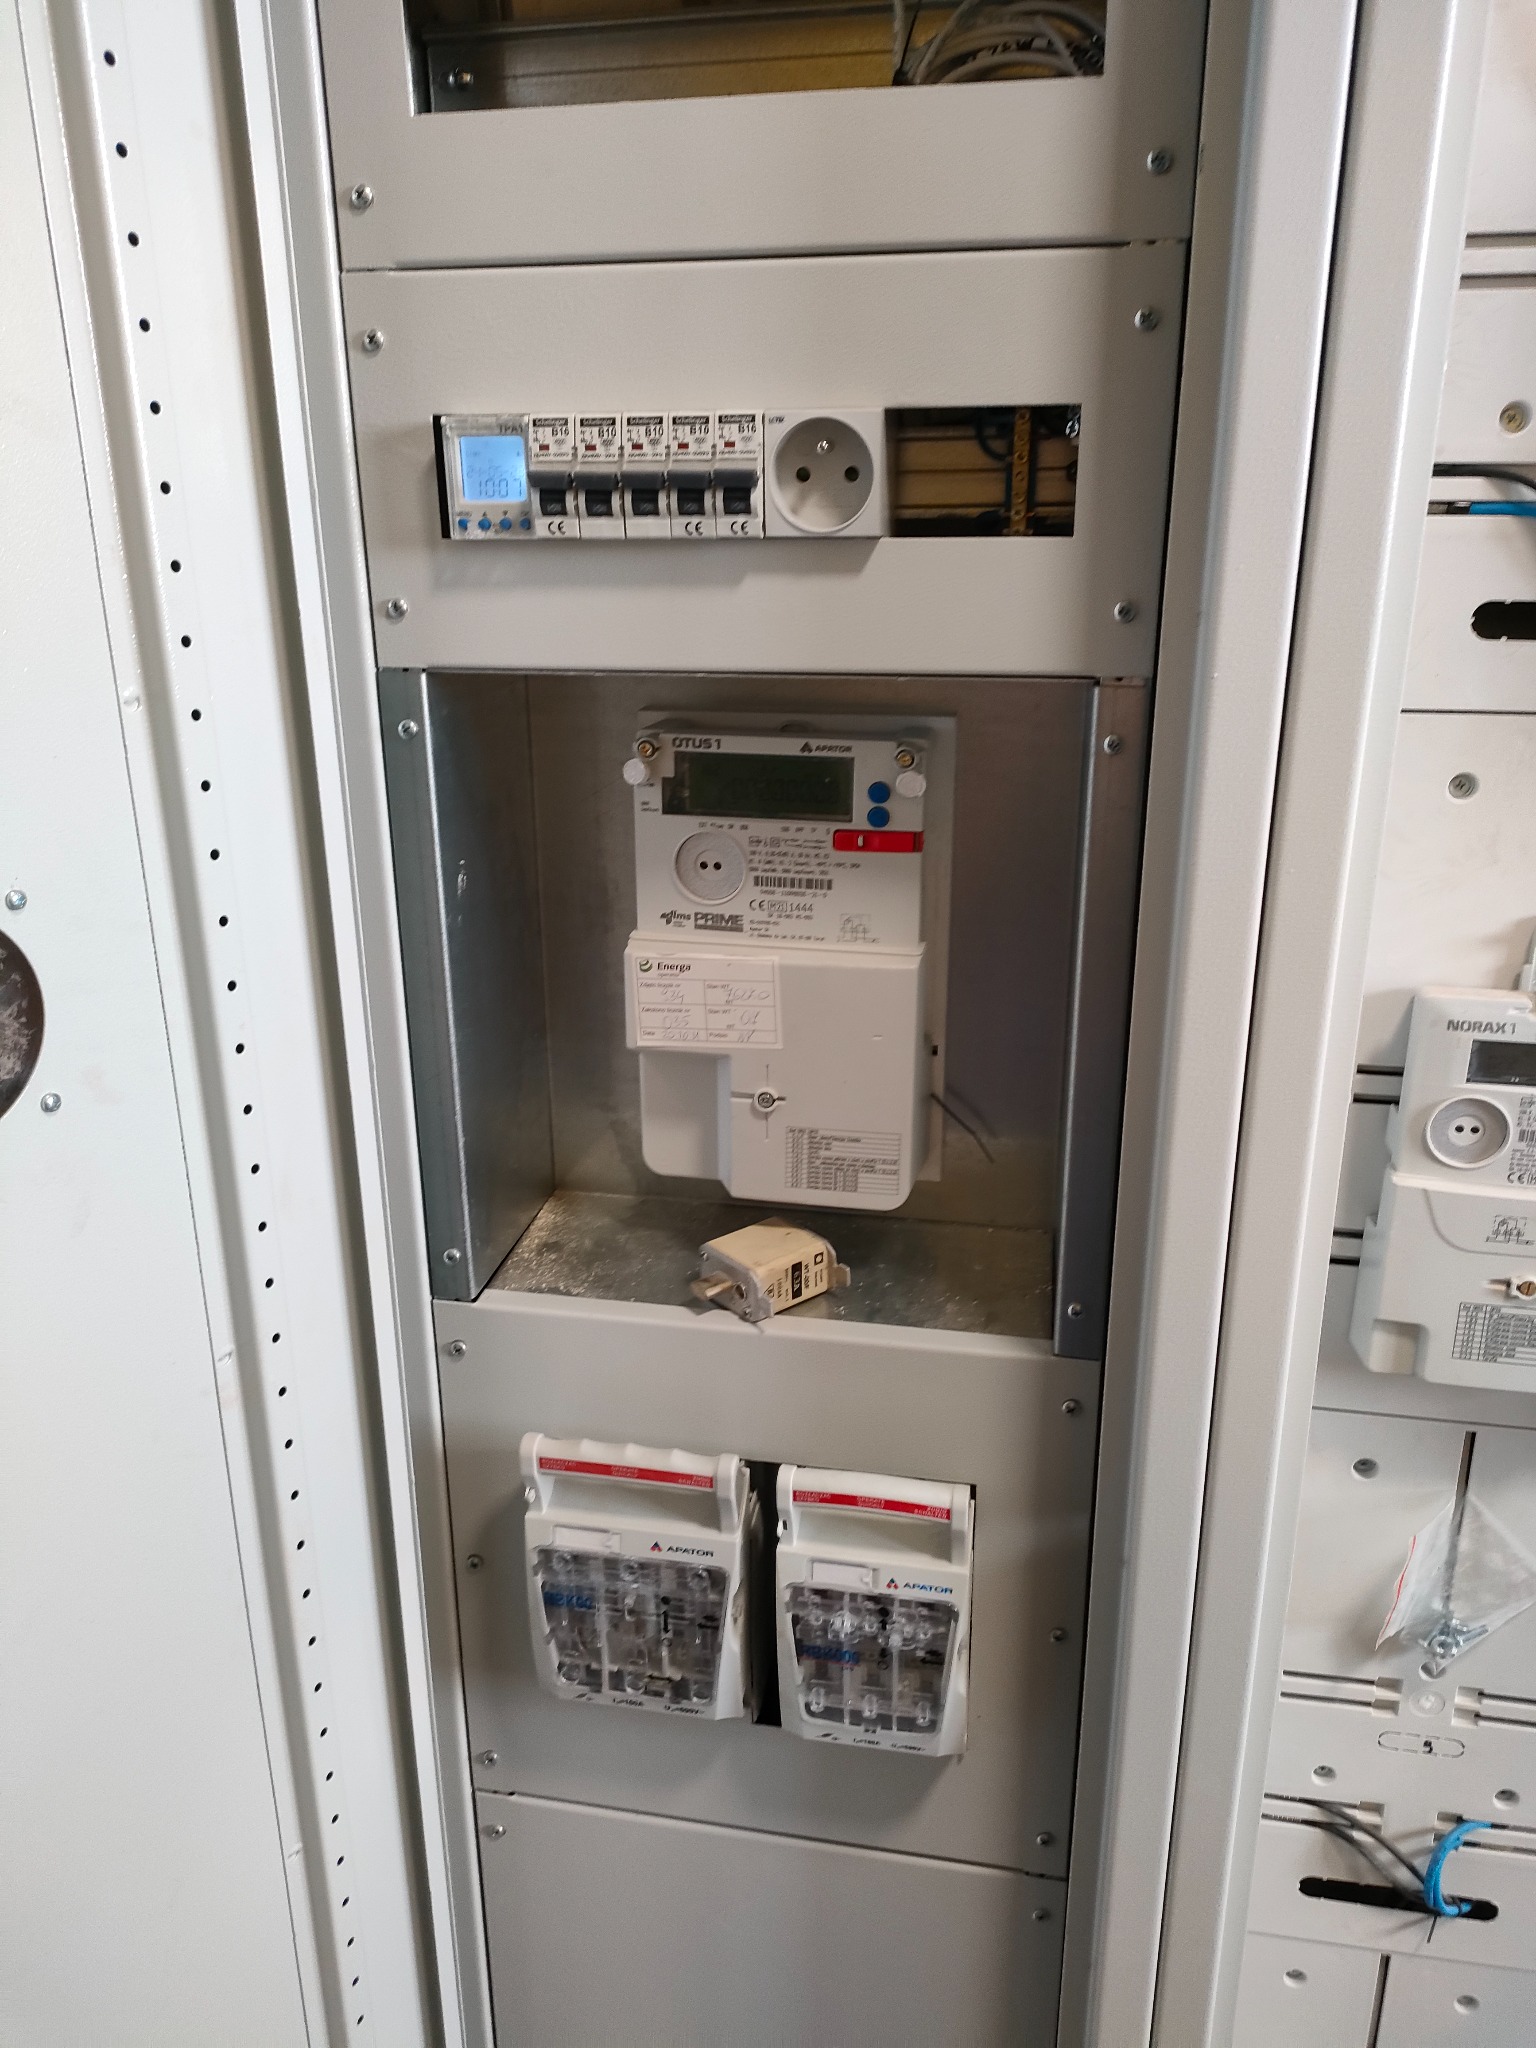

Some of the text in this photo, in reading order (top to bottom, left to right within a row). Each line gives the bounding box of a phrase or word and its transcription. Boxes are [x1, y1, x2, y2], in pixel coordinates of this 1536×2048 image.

[790, 902, 814, 912] 1444
[694, 912, 744, 926] PRIME
[657, 962, 691, 973] Energa
[667, 1545, 714, 1557] APATOR
[903, 1583, 953, 1595] APATOR
